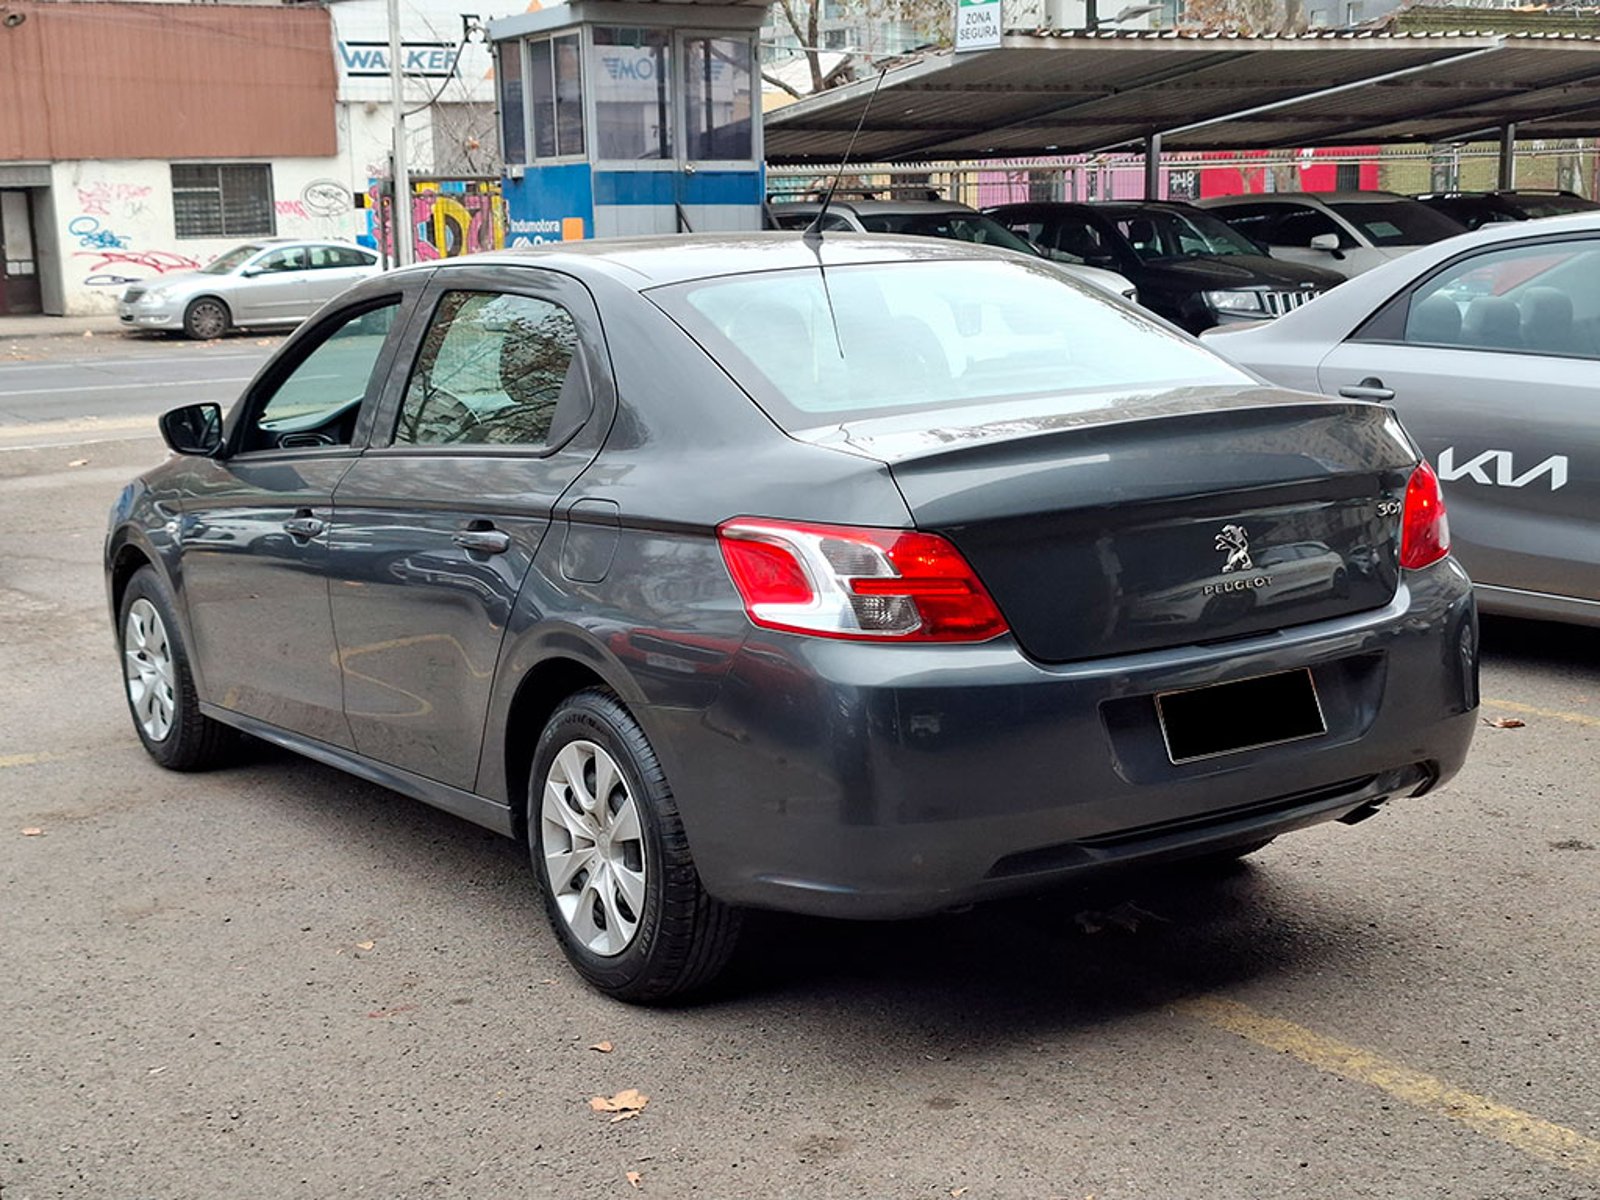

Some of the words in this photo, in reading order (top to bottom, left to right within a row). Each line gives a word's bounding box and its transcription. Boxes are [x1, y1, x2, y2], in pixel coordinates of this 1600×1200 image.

[966, 12, 991, 25] ZONA
[960, 26, 998, 40] SEGURA
[339, 44, 461, 76] WAKER
[510, 219, 560, 233] Indumotora
[1438, 447, 1567, 491] KIA
[1377, 501, 1402, 517] 301
[1203, 576, 1272, 595] PEUGEOT
